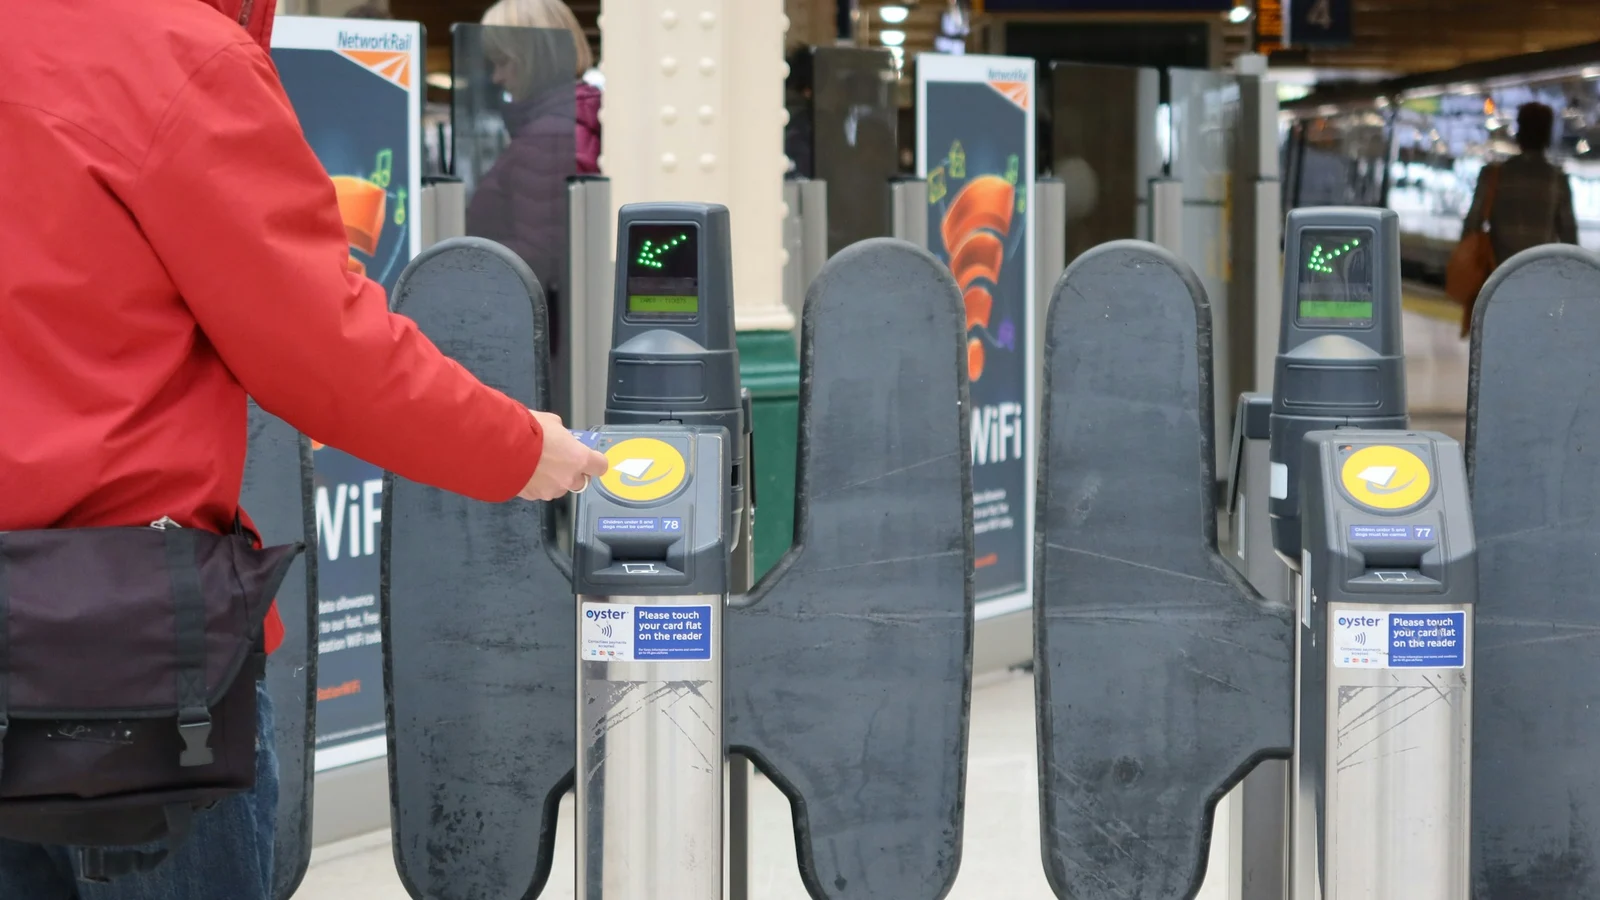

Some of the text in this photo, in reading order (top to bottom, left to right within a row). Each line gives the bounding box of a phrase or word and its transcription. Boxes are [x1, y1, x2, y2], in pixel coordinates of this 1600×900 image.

[338, 31, 412, 50] NetworkRail
[970, 402, 1021, 465] WiFi
[315, 479, 383, 560] WiF
[663, 520, 679, 530] 78
[1415, 528, 1431, 538] 77
[586, 609, 626, 622] oyster
[639, 610, 700, 620] Please touch
[638, 621, 702, 632] your card flat
[1338, 616, 1380, 629] oyster
[1393, 618, 1453, 627] Please touch
[638, 632, 703, 641] on the reader
[1393, 628, 1456, 639] your card flat
[1393, 639, 1456, 648] on the reader
